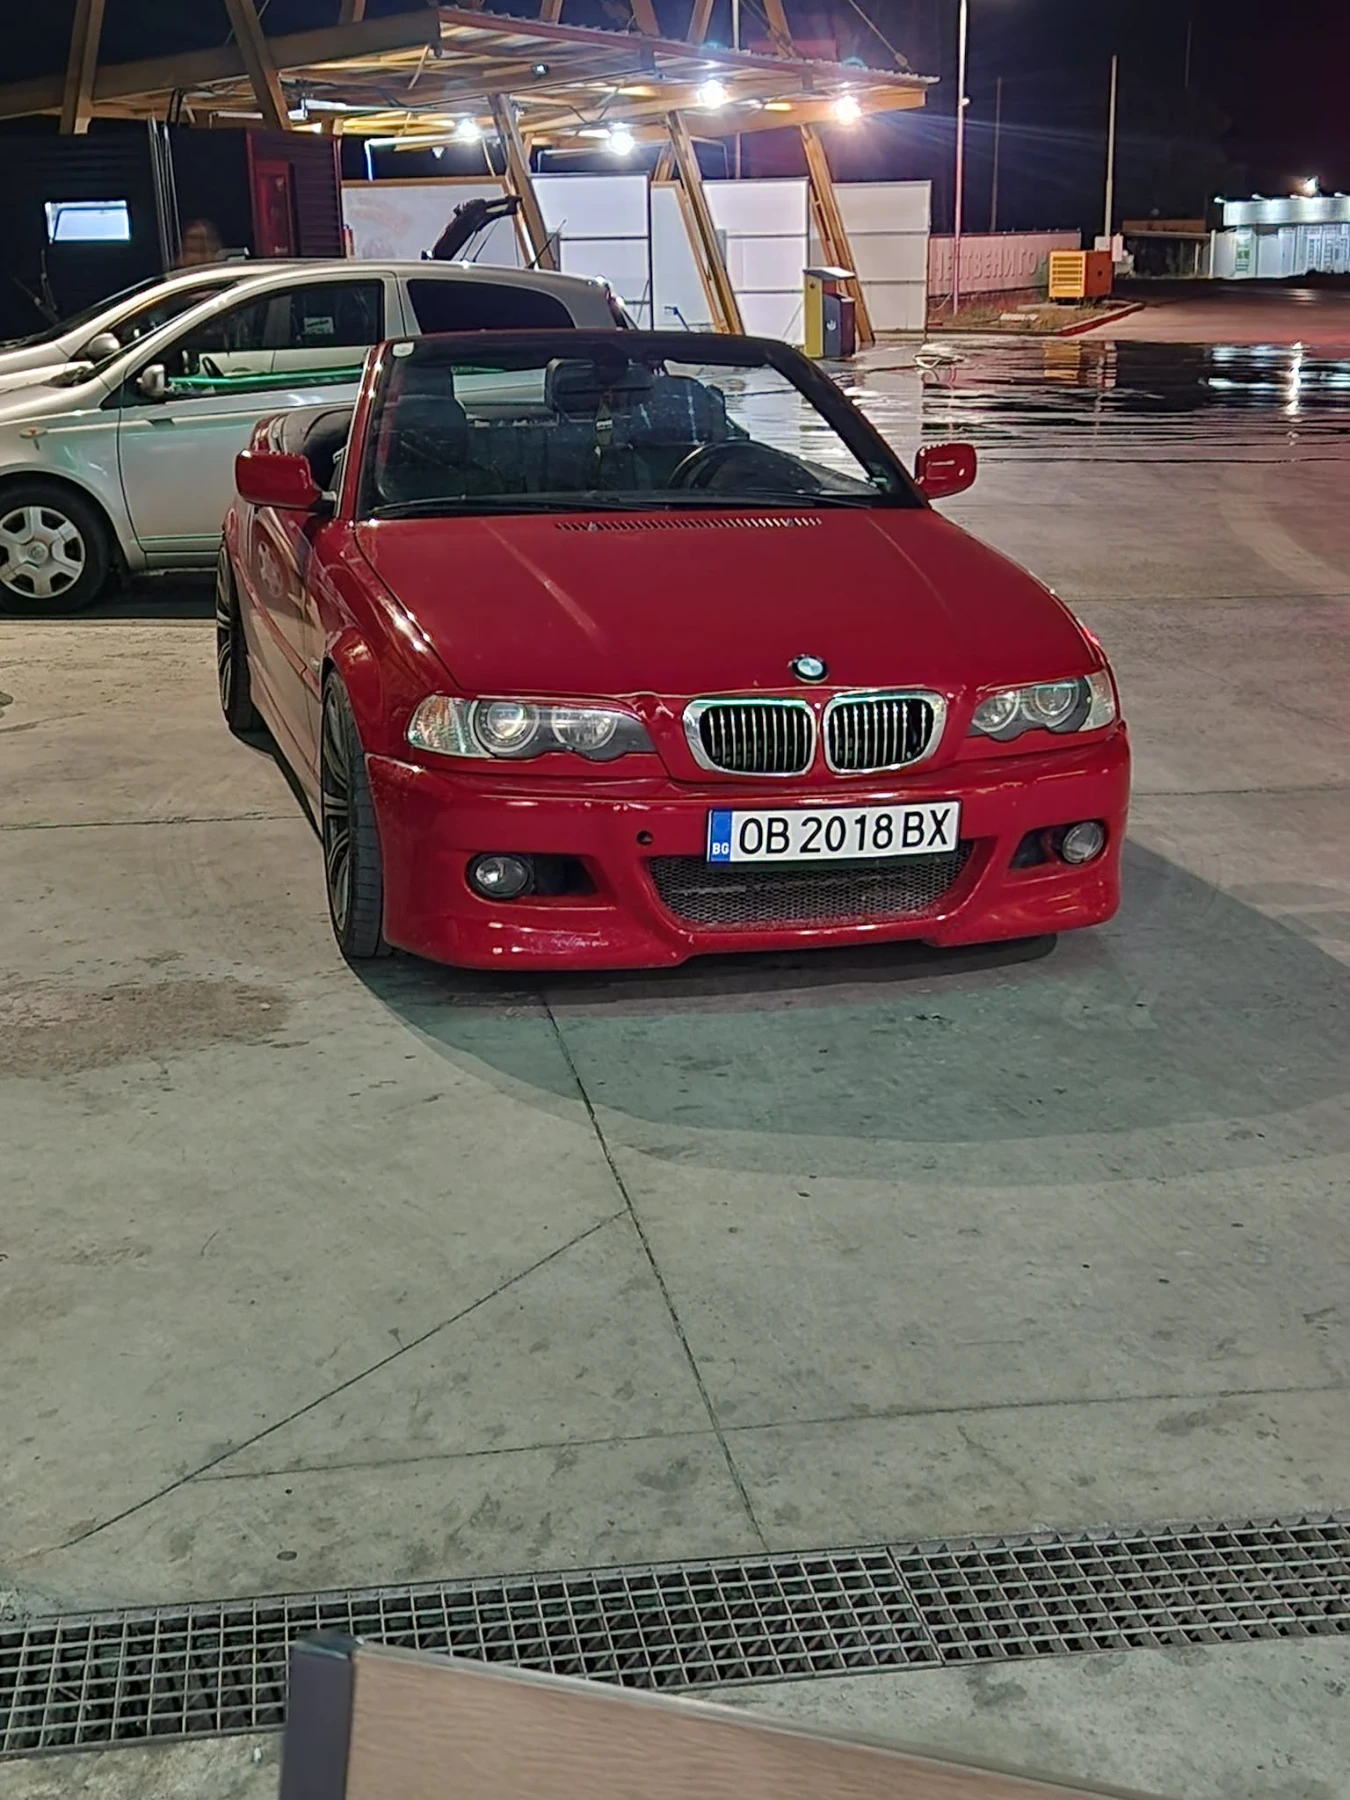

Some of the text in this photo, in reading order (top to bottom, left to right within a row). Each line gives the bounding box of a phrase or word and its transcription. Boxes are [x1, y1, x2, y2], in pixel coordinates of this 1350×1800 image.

[739, 808, 951, 855] OB 2018 BX
[712, 842, 729, 855] BG
